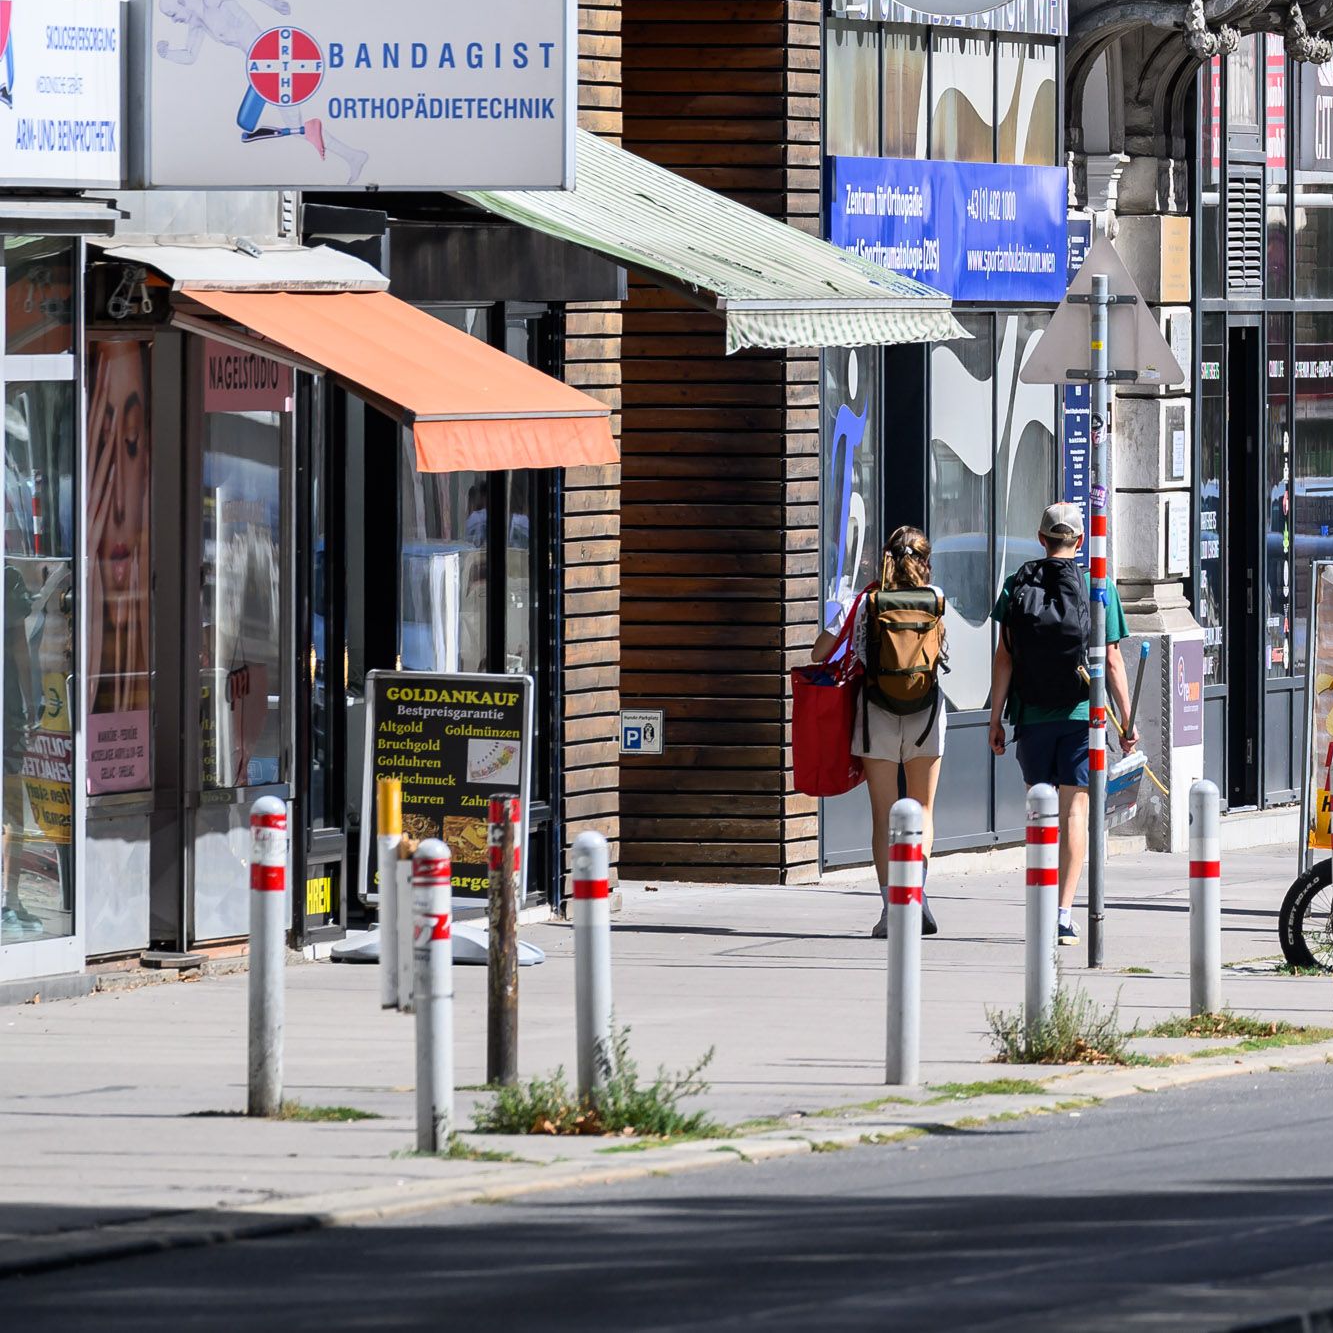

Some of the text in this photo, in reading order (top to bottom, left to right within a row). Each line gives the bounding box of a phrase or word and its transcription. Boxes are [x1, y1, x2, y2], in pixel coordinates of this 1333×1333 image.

[329, 42, 555, 69] BANDAGIST
[329, 94, 555, 119] ORTHOPÄDIETECHNIK
[38, 119, 55, 151] UND
[845, 184, 923, 224] Zentrum für Orthopädie
[966, 188, 979, 218] +43
[1001, 190, 1016, 221] 1000
[966, 244, 1056, 279] www.sportambulatorium.wien
[208, 354, 279, 390] NAGELSTUDIO
[386, 687, 520, 706] GOLDANKAUF
[397, 705, 504, 721] Bestpreisgarantie
[378, 721, 520, 739] Altgold Goldmünzen
[626, 730, 639, 746] P
[377, 738, 440, 753] Bruchgold
[377, 755, 441, 768] Golduhren
